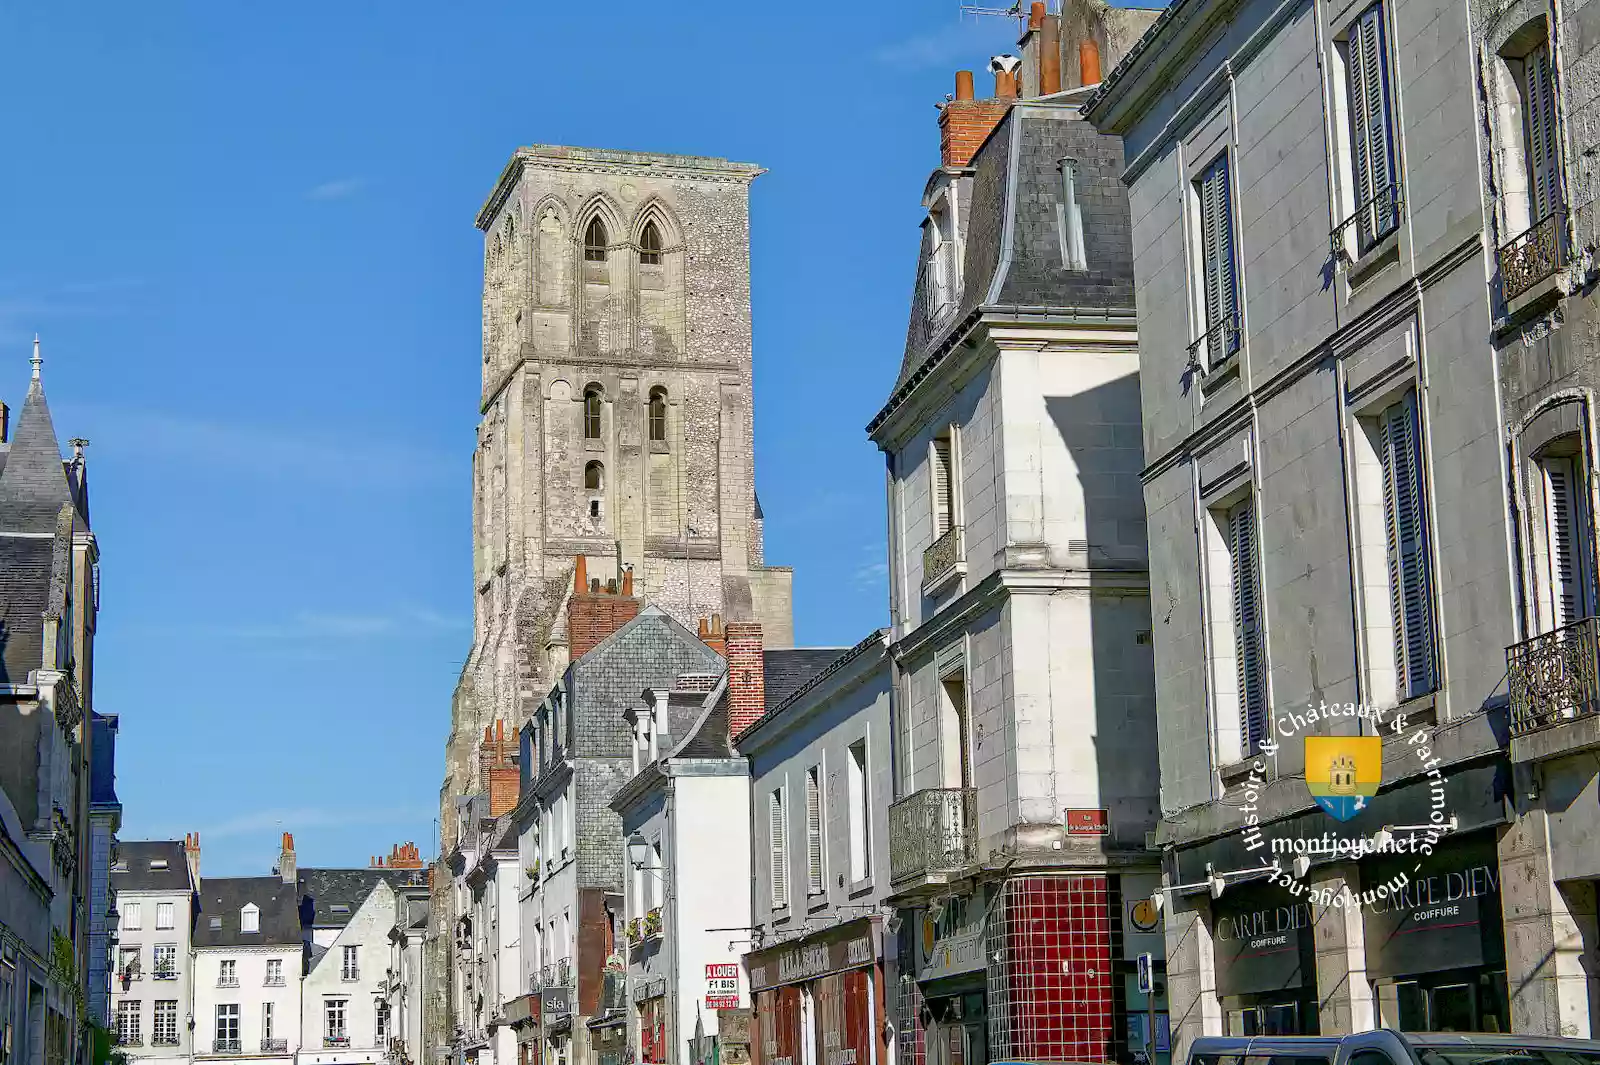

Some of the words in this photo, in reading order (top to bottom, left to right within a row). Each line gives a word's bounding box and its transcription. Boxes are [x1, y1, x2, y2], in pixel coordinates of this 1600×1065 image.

[1413, 905, 1460, 921] COIFFURE
[1217, 909, 1272, 942] CARPE
[1251, 936, 1287, 949] COIFFURE
[713, 965, 736, 977] LOUER
[709, 980, 718, 988] F1
[721, 980, 735, 988] BIS
[546, 996, 564, 1009] sia
